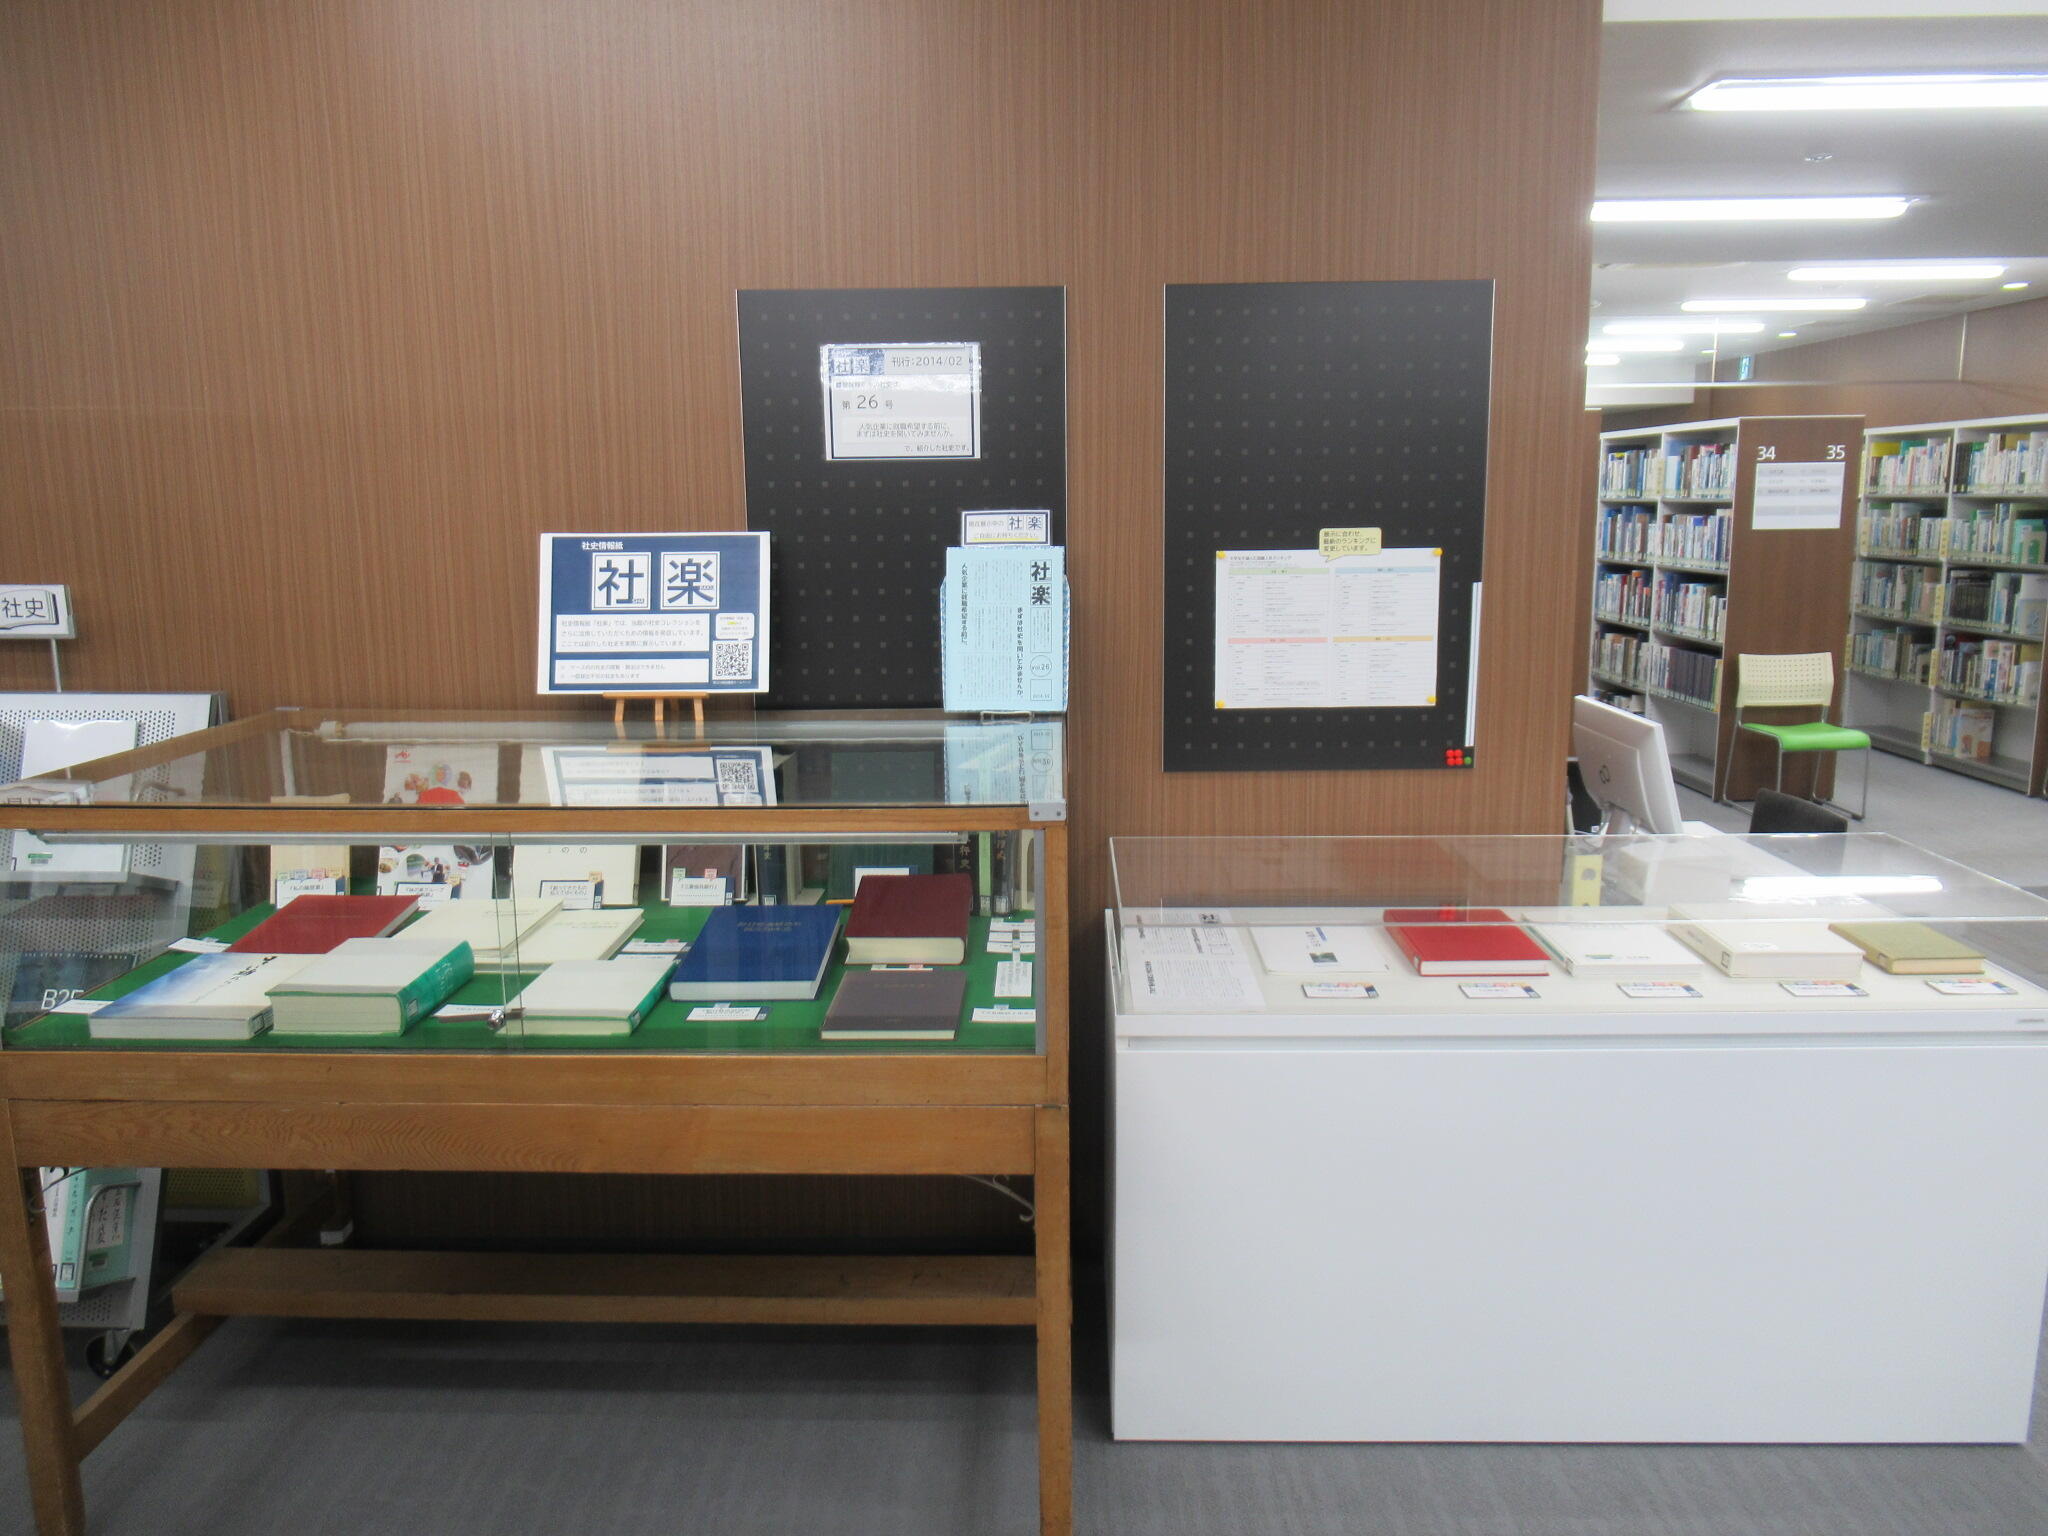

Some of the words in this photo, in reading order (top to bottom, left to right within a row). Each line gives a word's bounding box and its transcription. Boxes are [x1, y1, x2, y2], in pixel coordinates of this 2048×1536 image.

[857, 395, 878, 410] 26
[1757, 446, 1776, 460] 34
[1826, 445, 1846, 459] 35
[582, 541, 624, 551] 社史情報紙
[1031, 561, 1051, 606] 社楽
[1, 596, 46, 619] 社史
